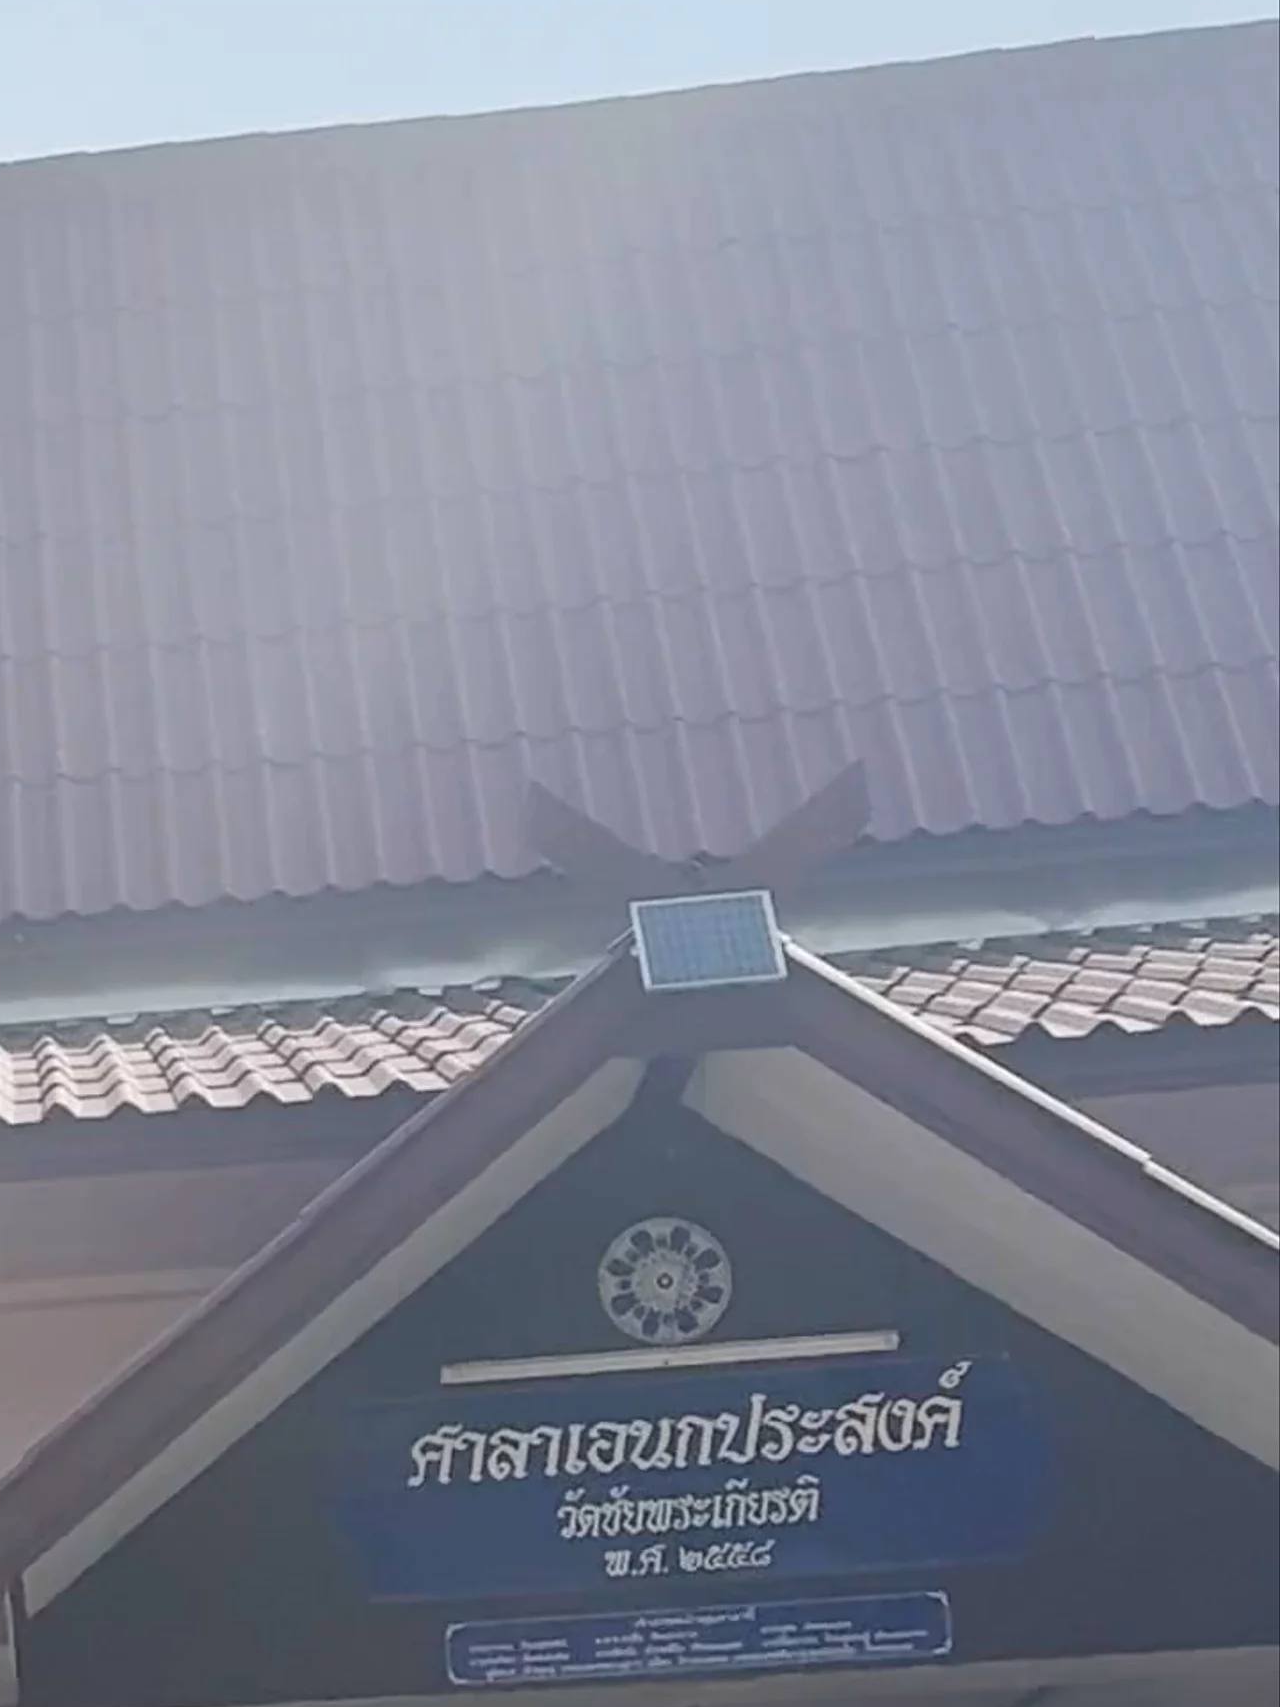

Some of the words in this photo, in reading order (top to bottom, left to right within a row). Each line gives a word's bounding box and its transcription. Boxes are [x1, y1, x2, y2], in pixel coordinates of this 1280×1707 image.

[407, 1361, 972, 1487] ศาลาเอนกประสงค์
[557, 1474, 820, 1539] วัดชัยพระเกียรติ
[603, 1544, 669, 1577] พ.ศ.
